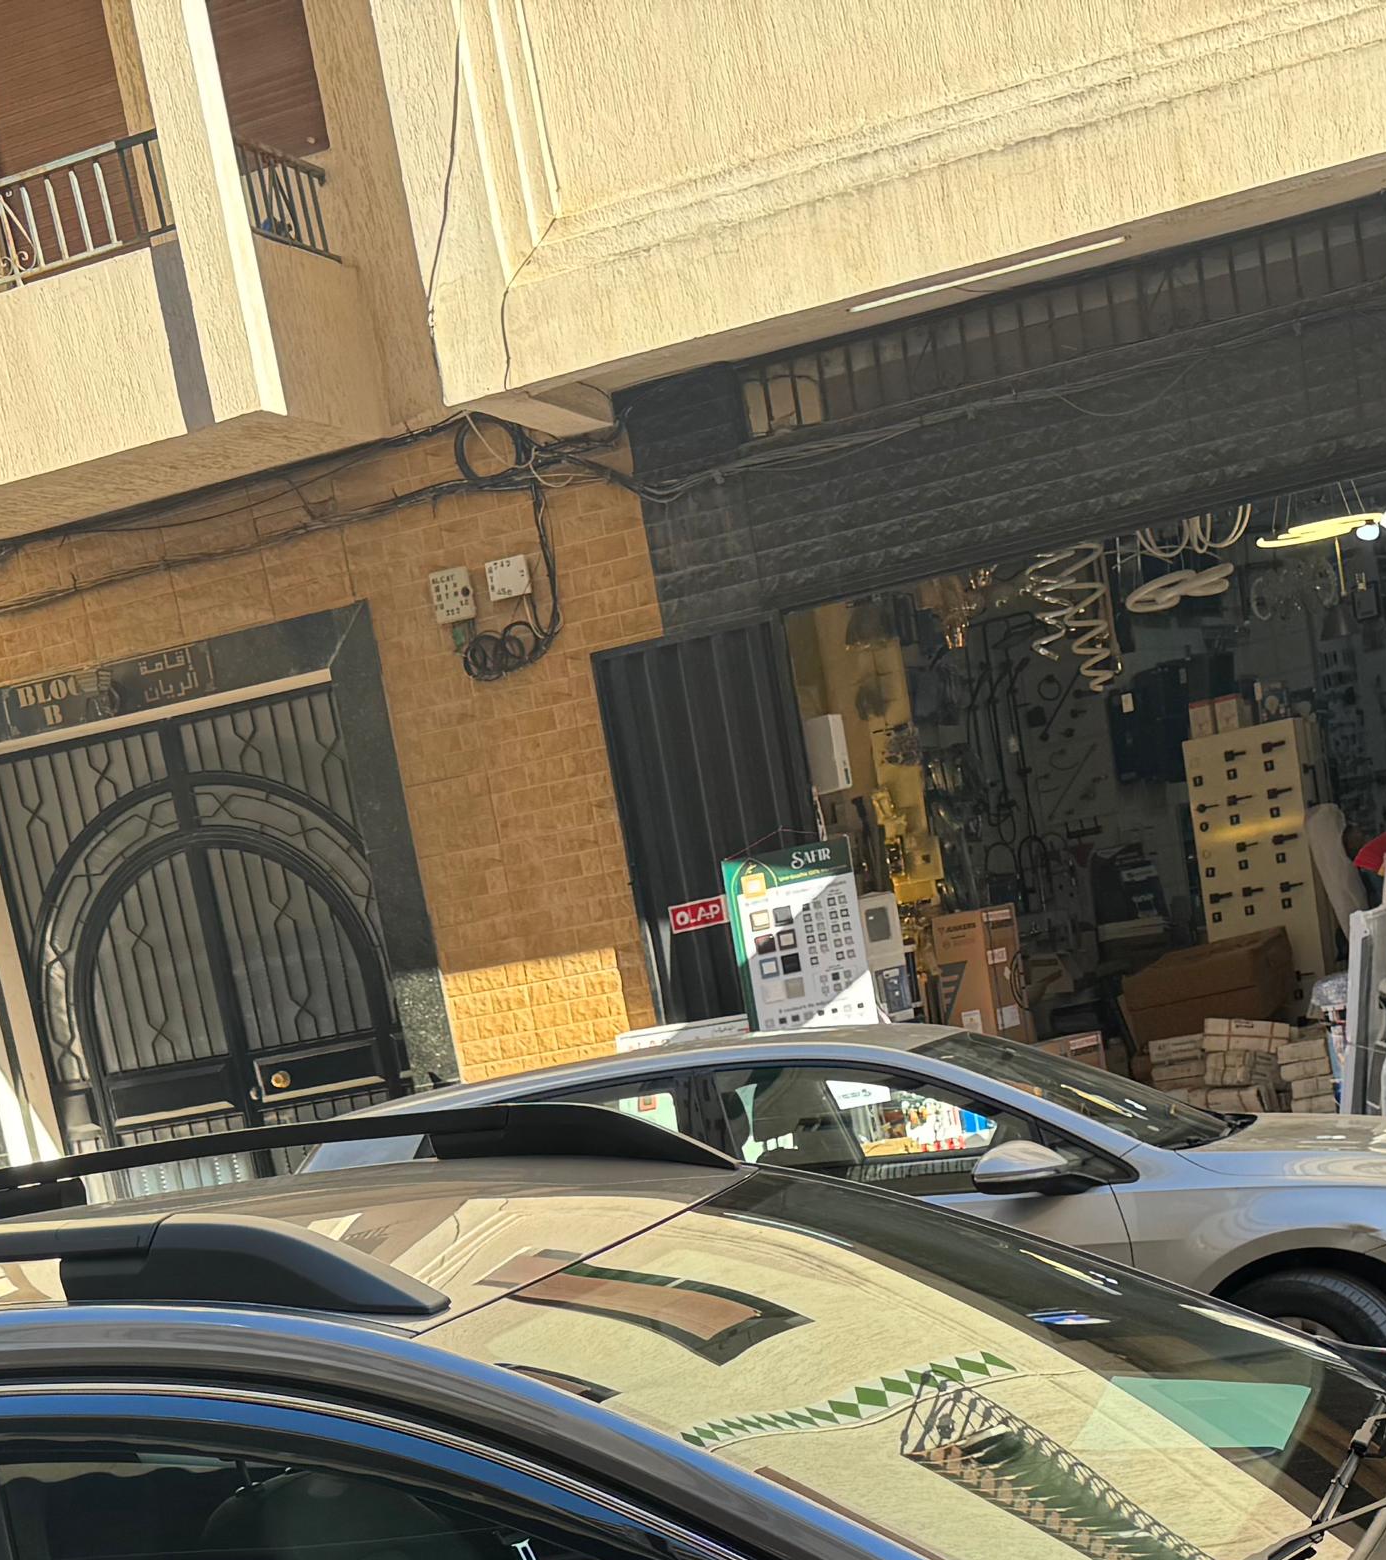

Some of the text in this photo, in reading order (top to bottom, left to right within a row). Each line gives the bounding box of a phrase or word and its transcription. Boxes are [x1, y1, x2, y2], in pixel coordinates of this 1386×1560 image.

[138, 648, 192, 676] إقامة
[144, 671, 200, 703] الريان
[43, 704, 63, 726] B
